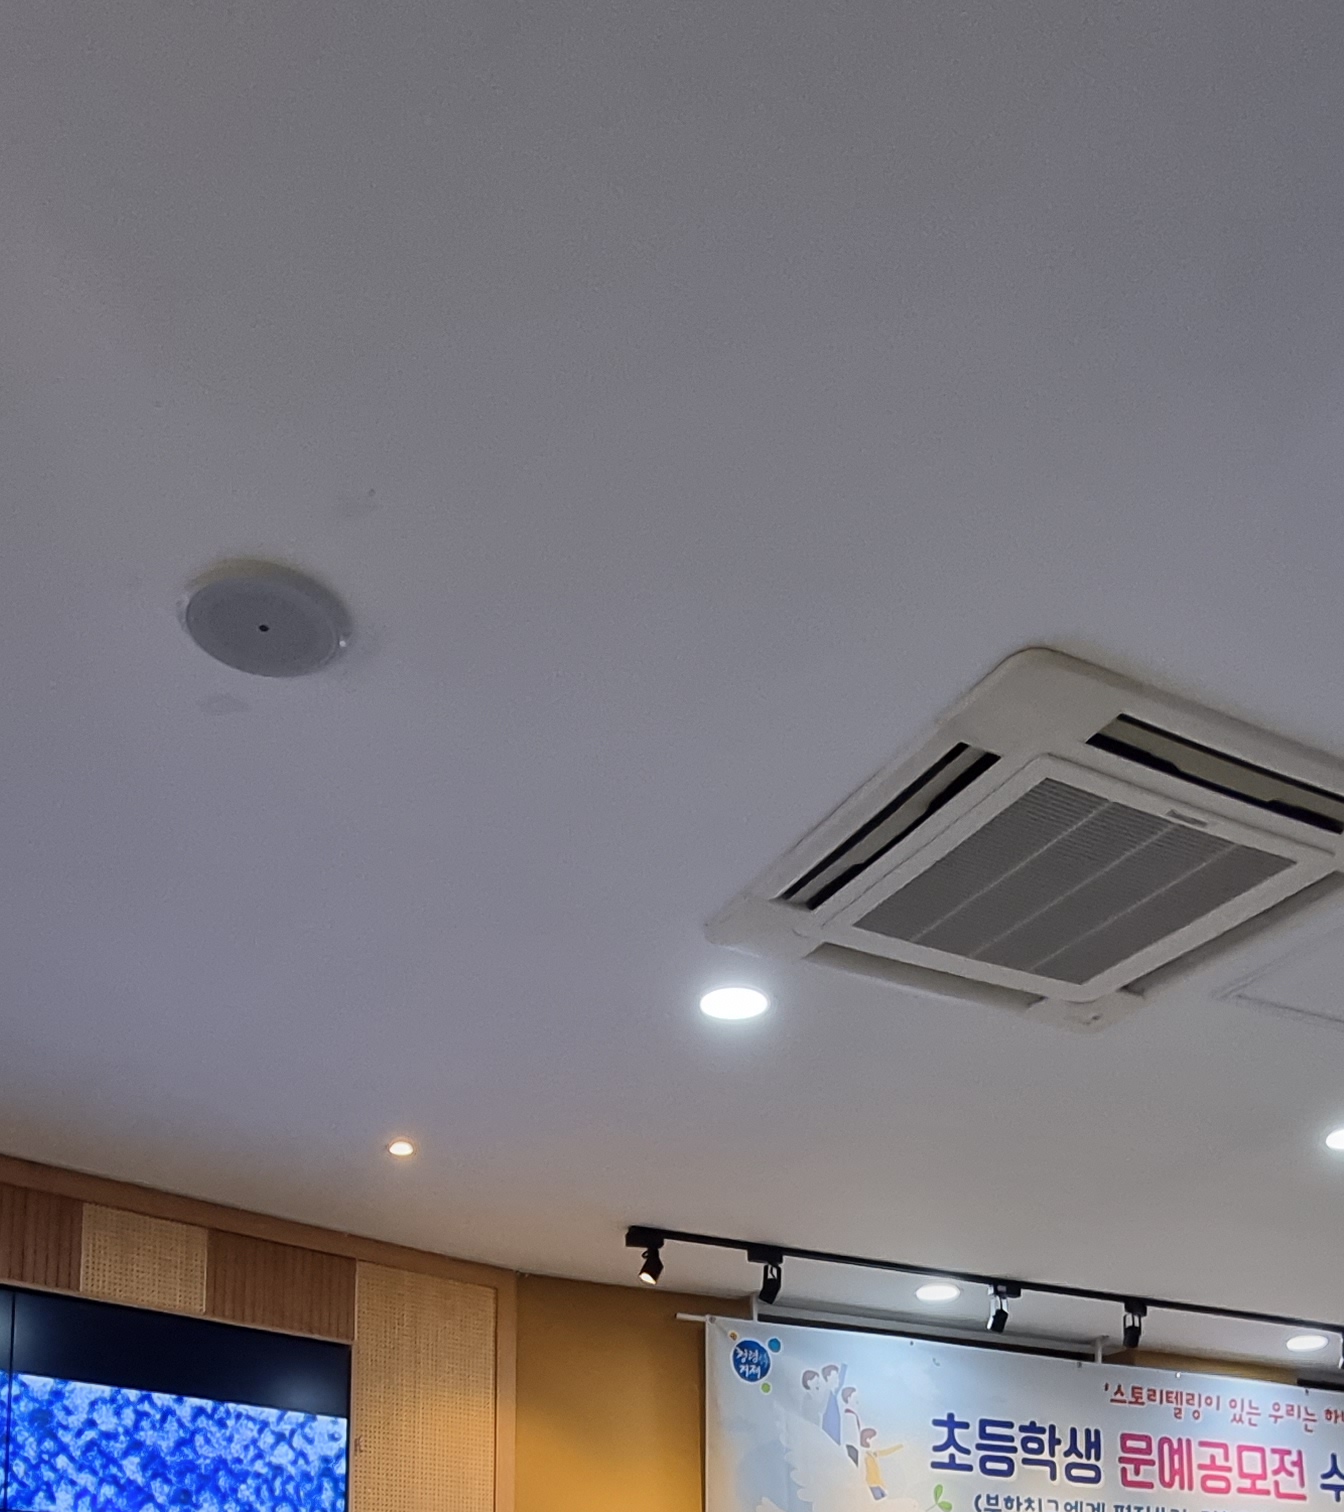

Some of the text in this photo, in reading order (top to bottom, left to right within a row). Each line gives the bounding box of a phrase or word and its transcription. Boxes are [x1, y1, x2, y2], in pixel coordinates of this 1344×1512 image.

[1228, 1397, 1262, 1428] 있는
[1268, 1401, 1318, 1433] 우리는
[930, 1412, 1102, 1485] 초등학생
[1118, 1432, 1308, 1501] 문예공모전
